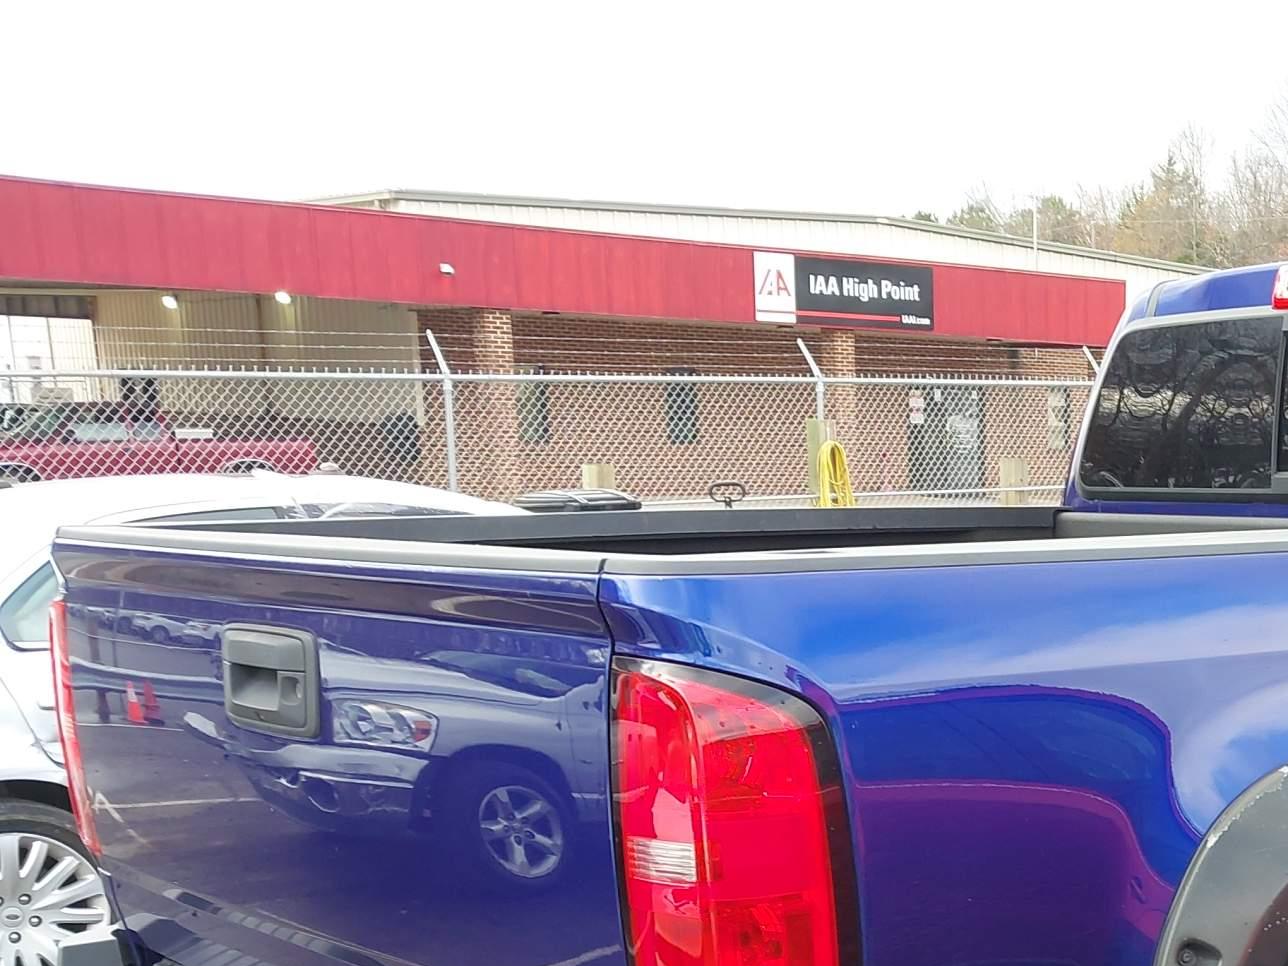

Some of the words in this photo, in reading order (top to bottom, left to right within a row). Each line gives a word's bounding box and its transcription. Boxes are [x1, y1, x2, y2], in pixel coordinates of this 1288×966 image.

[808, 273, 840, 297] IAA
[842, 277, 879, 302] High
[880, 279, 920, 302] Point
